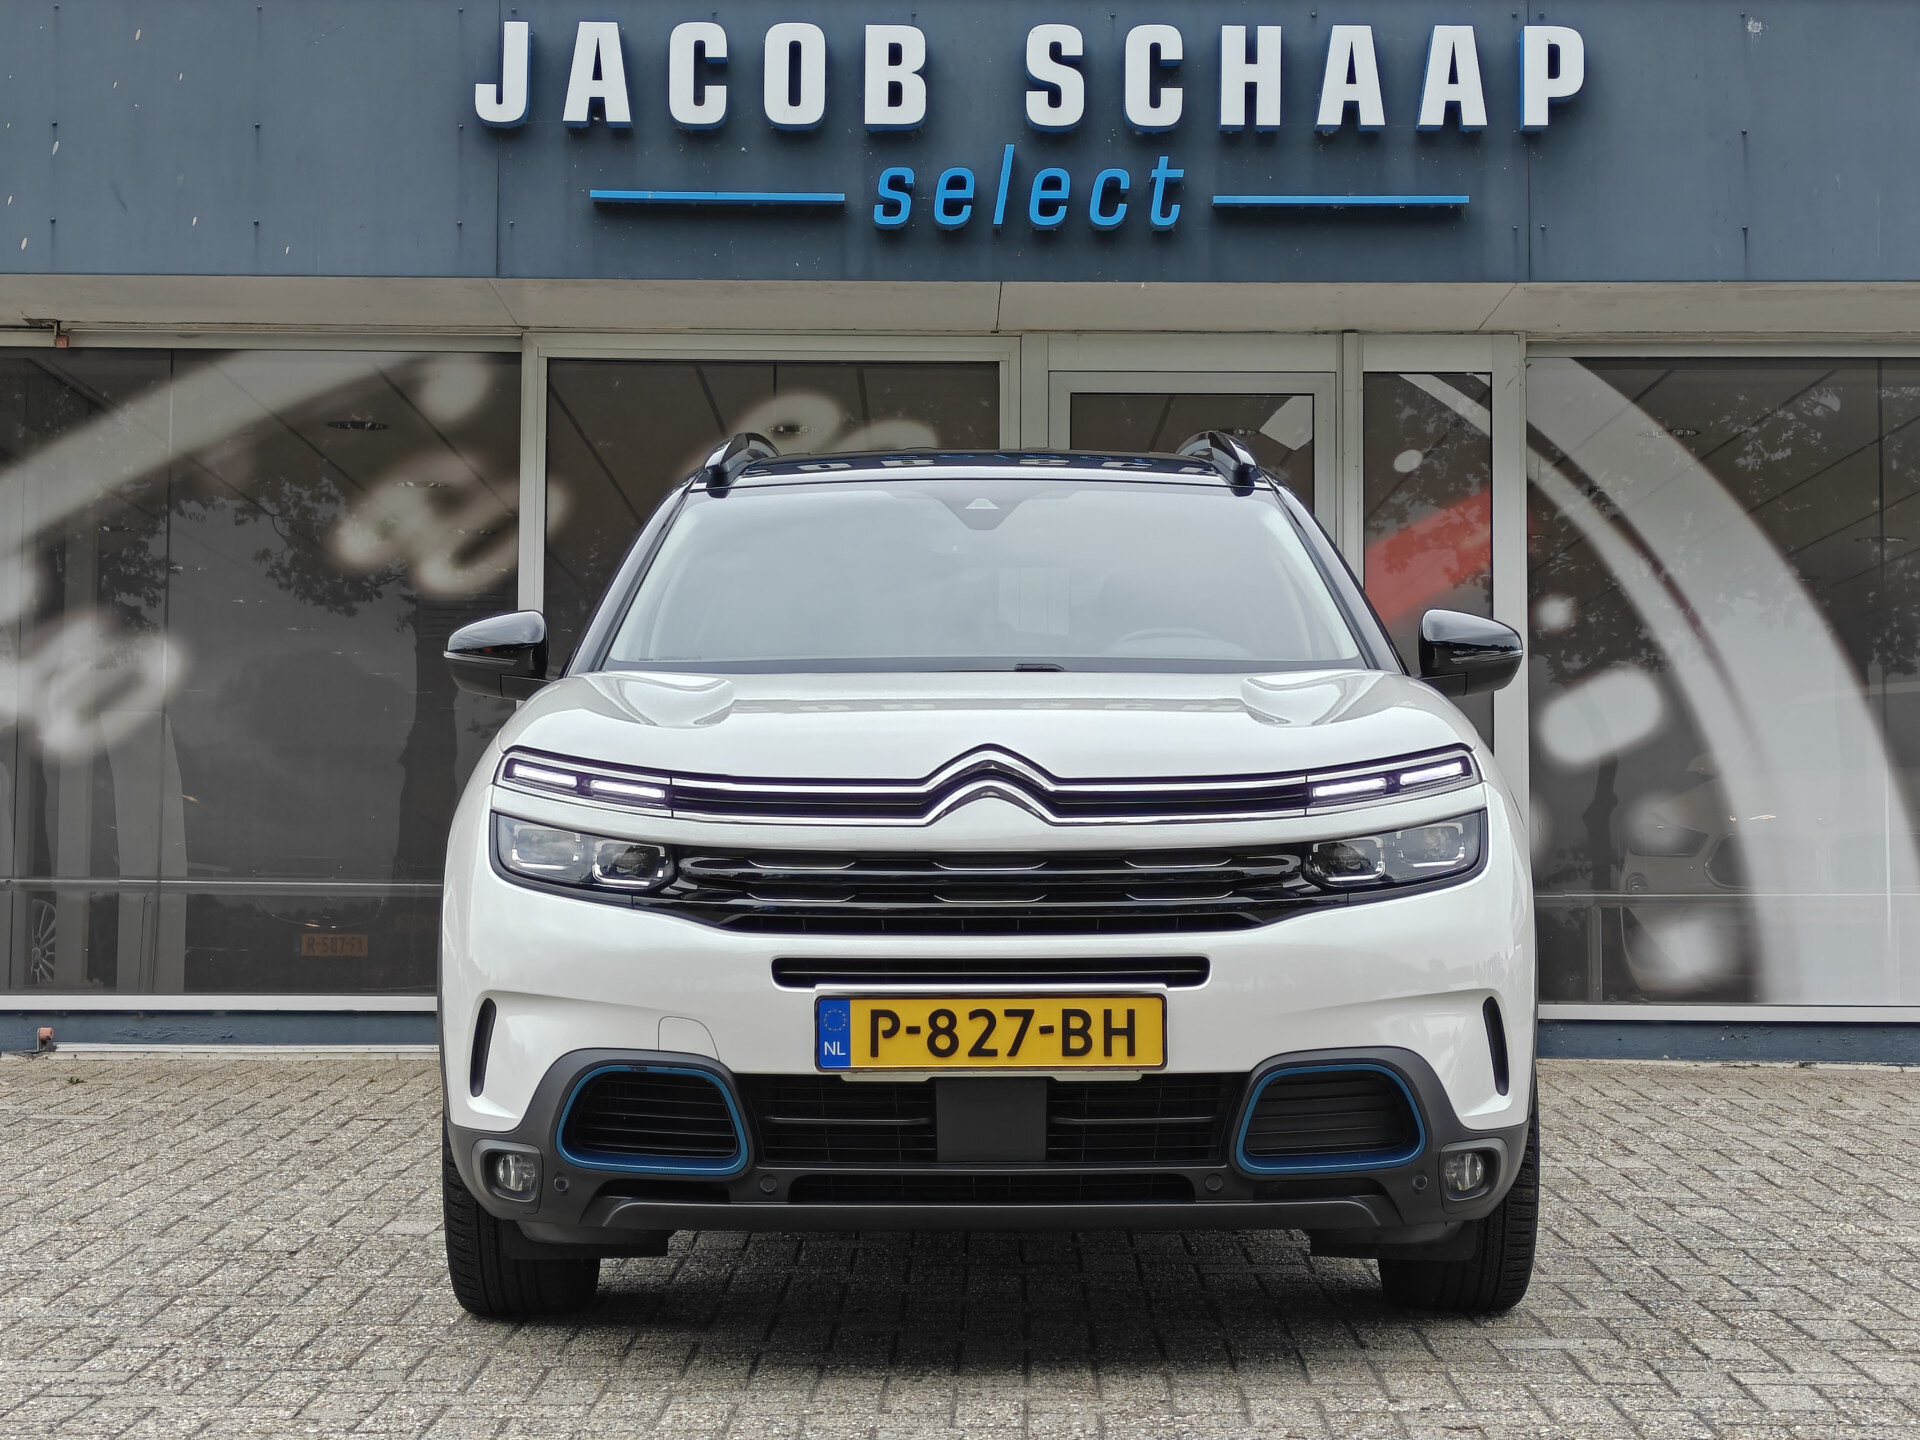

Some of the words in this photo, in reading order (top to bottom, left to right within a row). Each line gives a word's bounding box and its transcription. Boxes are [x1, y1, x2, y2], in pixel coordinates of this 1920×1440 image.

[475, 21, 928, 130] JACOB
[1026, 23, 1585, 131] SCHAAP
[873, 144, 1185, 228] select
[824, 1041, 846, 1056] NL
[870, 1008, 1136, 1058] P-827-BH
